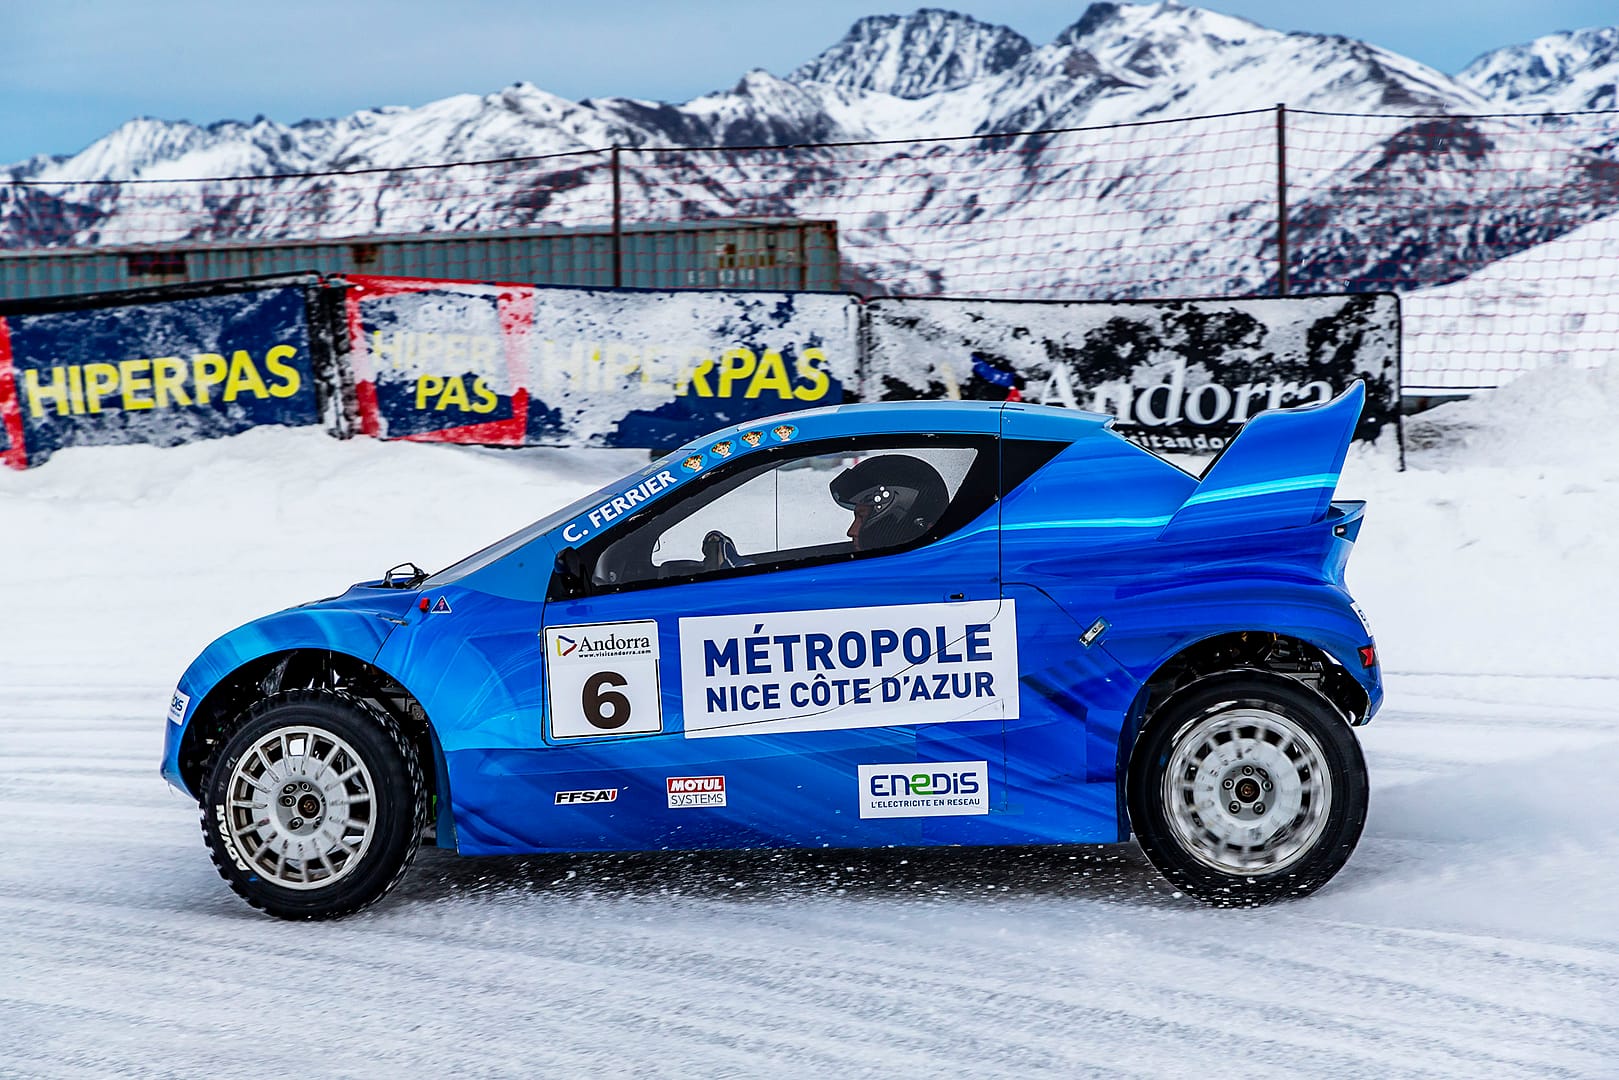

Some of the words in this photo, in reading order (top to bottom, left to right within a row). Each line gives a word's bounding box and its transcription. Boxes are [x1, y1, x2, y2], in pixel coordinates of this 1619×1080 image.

[25, 345, 301, 417] HIPERPAS
[415, 374, 498, 413] PAS
[562, 523, 589, 542] C.
[588, 470, 678, 528] FERRIER
[578, 633, 650, 652] Andorra
[578, 649, 651, 658] www.visitandorra.com
[704, 623, 993, 677] MÉTROPOLE
[581, 671, 631, 729] 6
[706, 684, 781, 713] NICE
[790, 673, 871, 705] CÔTE
[882, 671, 996, 702] D'AZUR
[556, 790, 610, 803] FFSA
[670, 779, 722, 791] MOTUL
[671, 794, 724, 806] SYSTEMS
[947, 798, 980, 806] RESEAU
[215, 804, 251, 870] ADVAN
